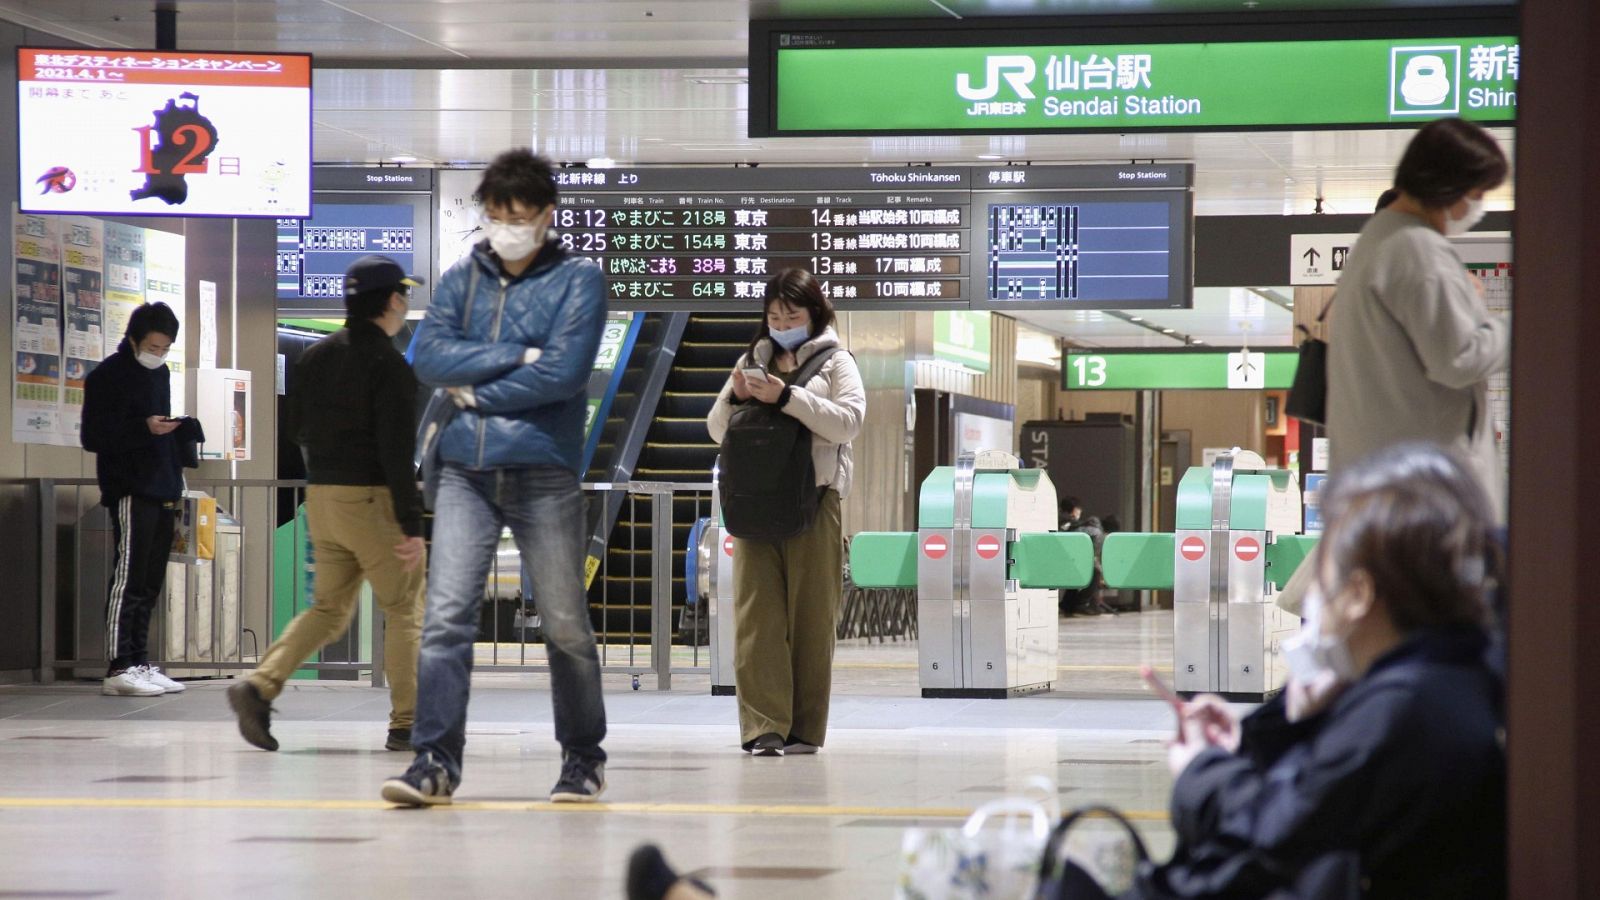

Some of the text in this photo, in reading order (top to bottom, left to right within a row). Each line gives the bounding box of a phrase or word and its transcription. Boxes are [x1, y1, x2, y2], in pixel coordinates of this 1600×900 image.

[956, 55, 1037, 100] JR
[1045, 53, 1152, 91] 仙台駅
[967, 102, 1026, 116] JR東日本
[1044, 96, 1201, 116] Sendai Station
[131, 123, 240, 176] 12 日
[366, 174, 413, 183] Stop Stations
[553, 173, 638, 185] 北新幹線 上り
[870, 172, 961, 182] Tōhoku Shinkansen
[988, 170, 1026, 184] 停車駅
[1118, 171, 1167, 180] Stop Stations
[623, 197, 644, 205] 列車名
[906, 196, 932, 204] Remarks
[553, 209, 606, 228] 18:12
[611, 210, 675, 226] やまびこ
[682, 210, 726, 226] 218号
[734, 208, 768, 226] 東京
[561, 233, 607, 251] 8:25
[611, 234, 675, 250] やまびこ
[684, 234, 726, 250] 154号
[734, 232, 768, 250] 東京
[692, 258, 726, 274] 38号
[734, 256, 768, 274] 東京
[876, 257, 942, 274] 17両編成
[611, 280, 942, 298] やまびこ 64号 東京 4番線 10両編成
[1073, 355, 1107, 387] 13
[932, 662, 939, 671] 6
[986, 662, 993, 671] 5
[1188, 664, 1194, 673] 5
[1243, 664, 1250, 674] 4
